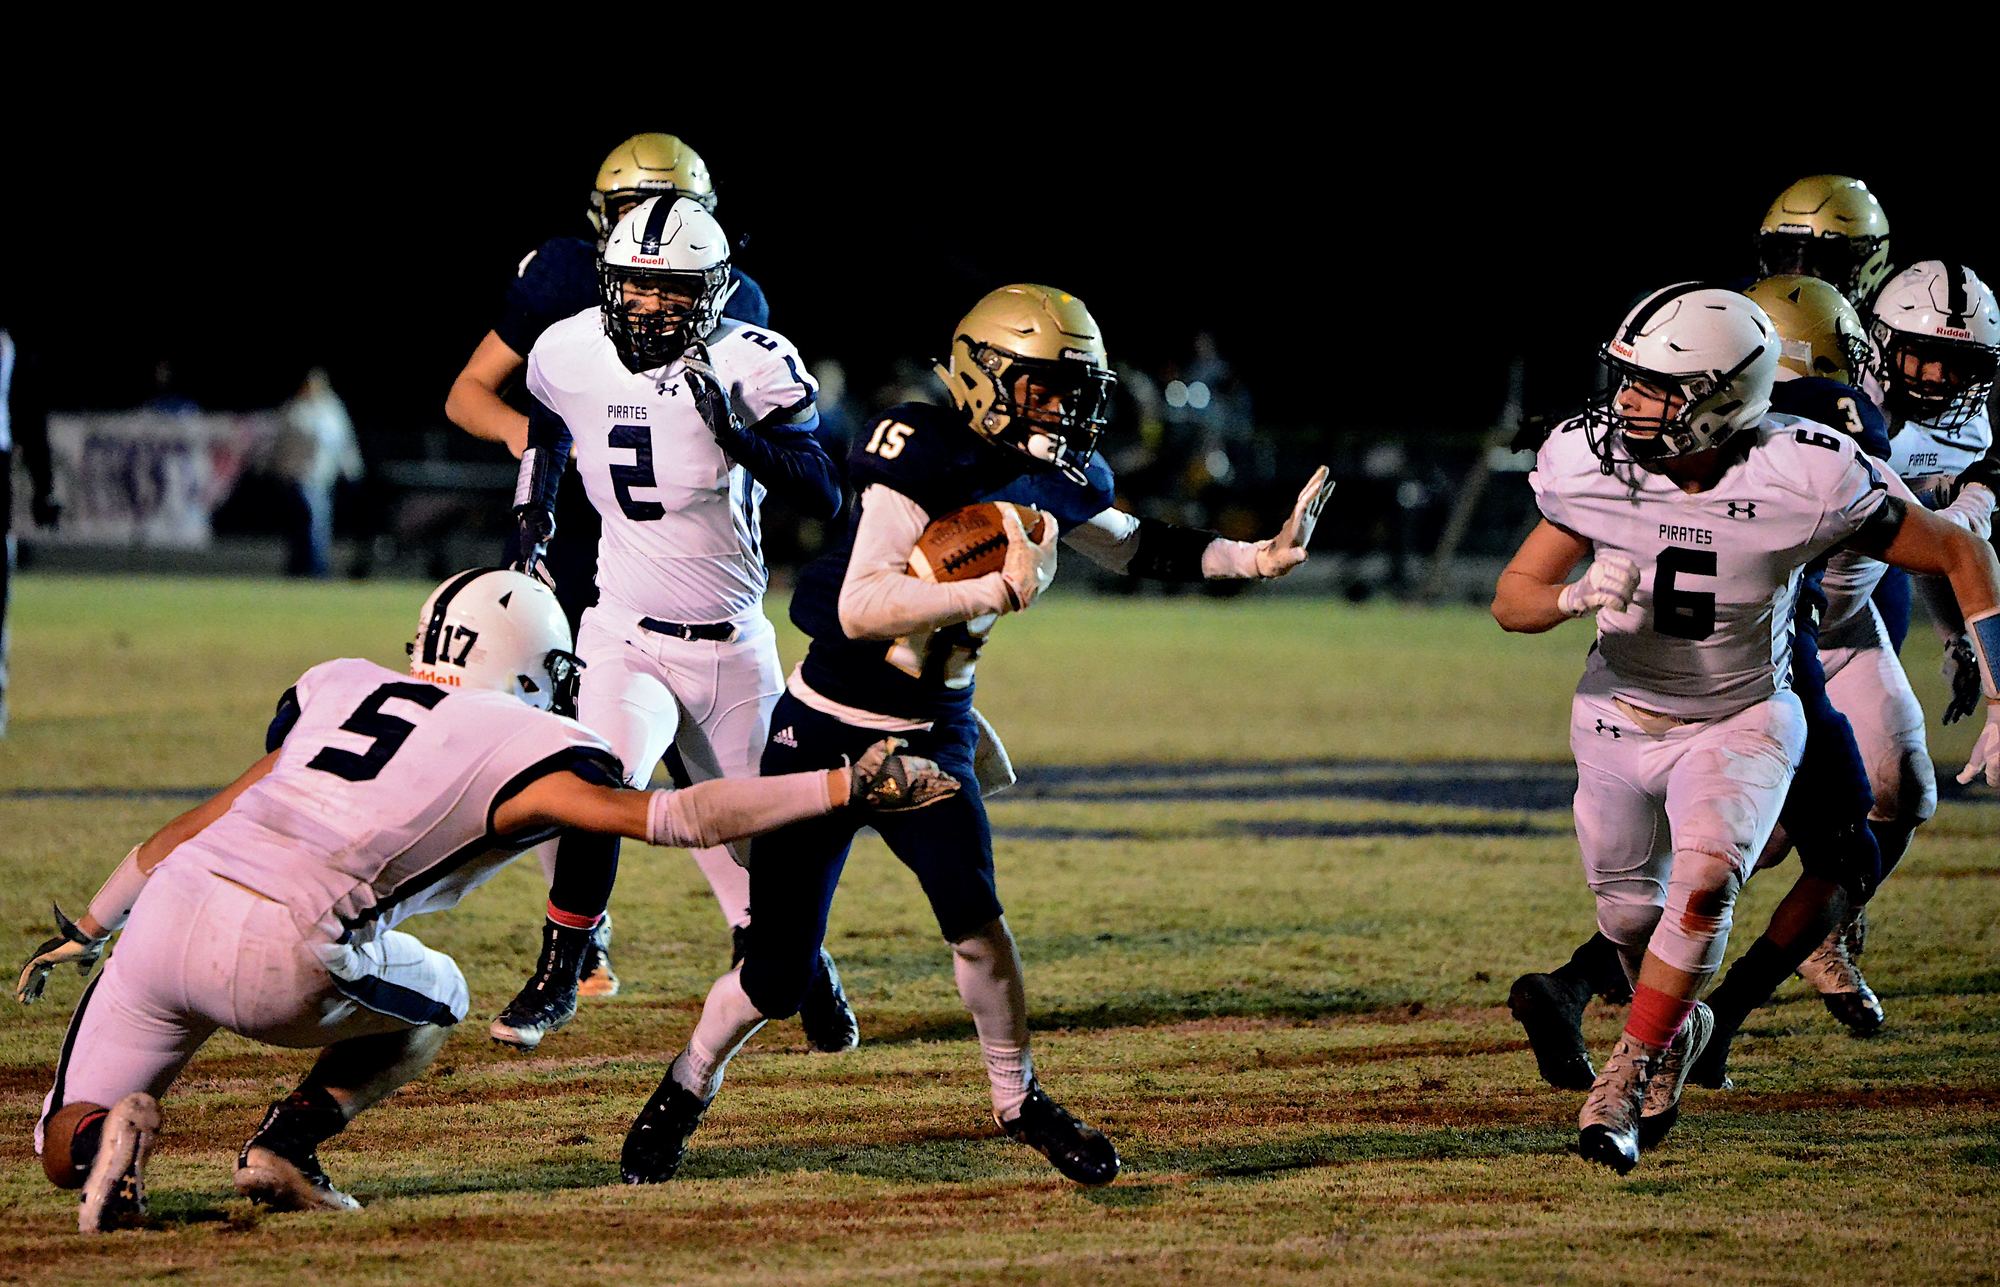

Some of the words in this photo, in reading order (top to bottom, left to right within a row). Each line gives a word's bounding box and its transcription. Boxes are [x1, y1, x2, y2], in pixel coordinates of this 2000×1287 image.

[741, 330, 778, 352] 2
[1936, 327, 1971, 339] Riddell
[607, 404, 648, 420] PIRATES
[1837, 396, 1864, 434] 3
[864, 418, 916, 460] 15
[1795, 428, 1841, 453] 6
[607, 424, 667, 522] 2
[1908, 452, 1939, 467] PIRATES
[1658, 523, 1713, 545] PIRATES
[1652, 545, 1718, 642] 6
[438, 624, 479, 669] 17
[305, 681, 450, 783] 5
